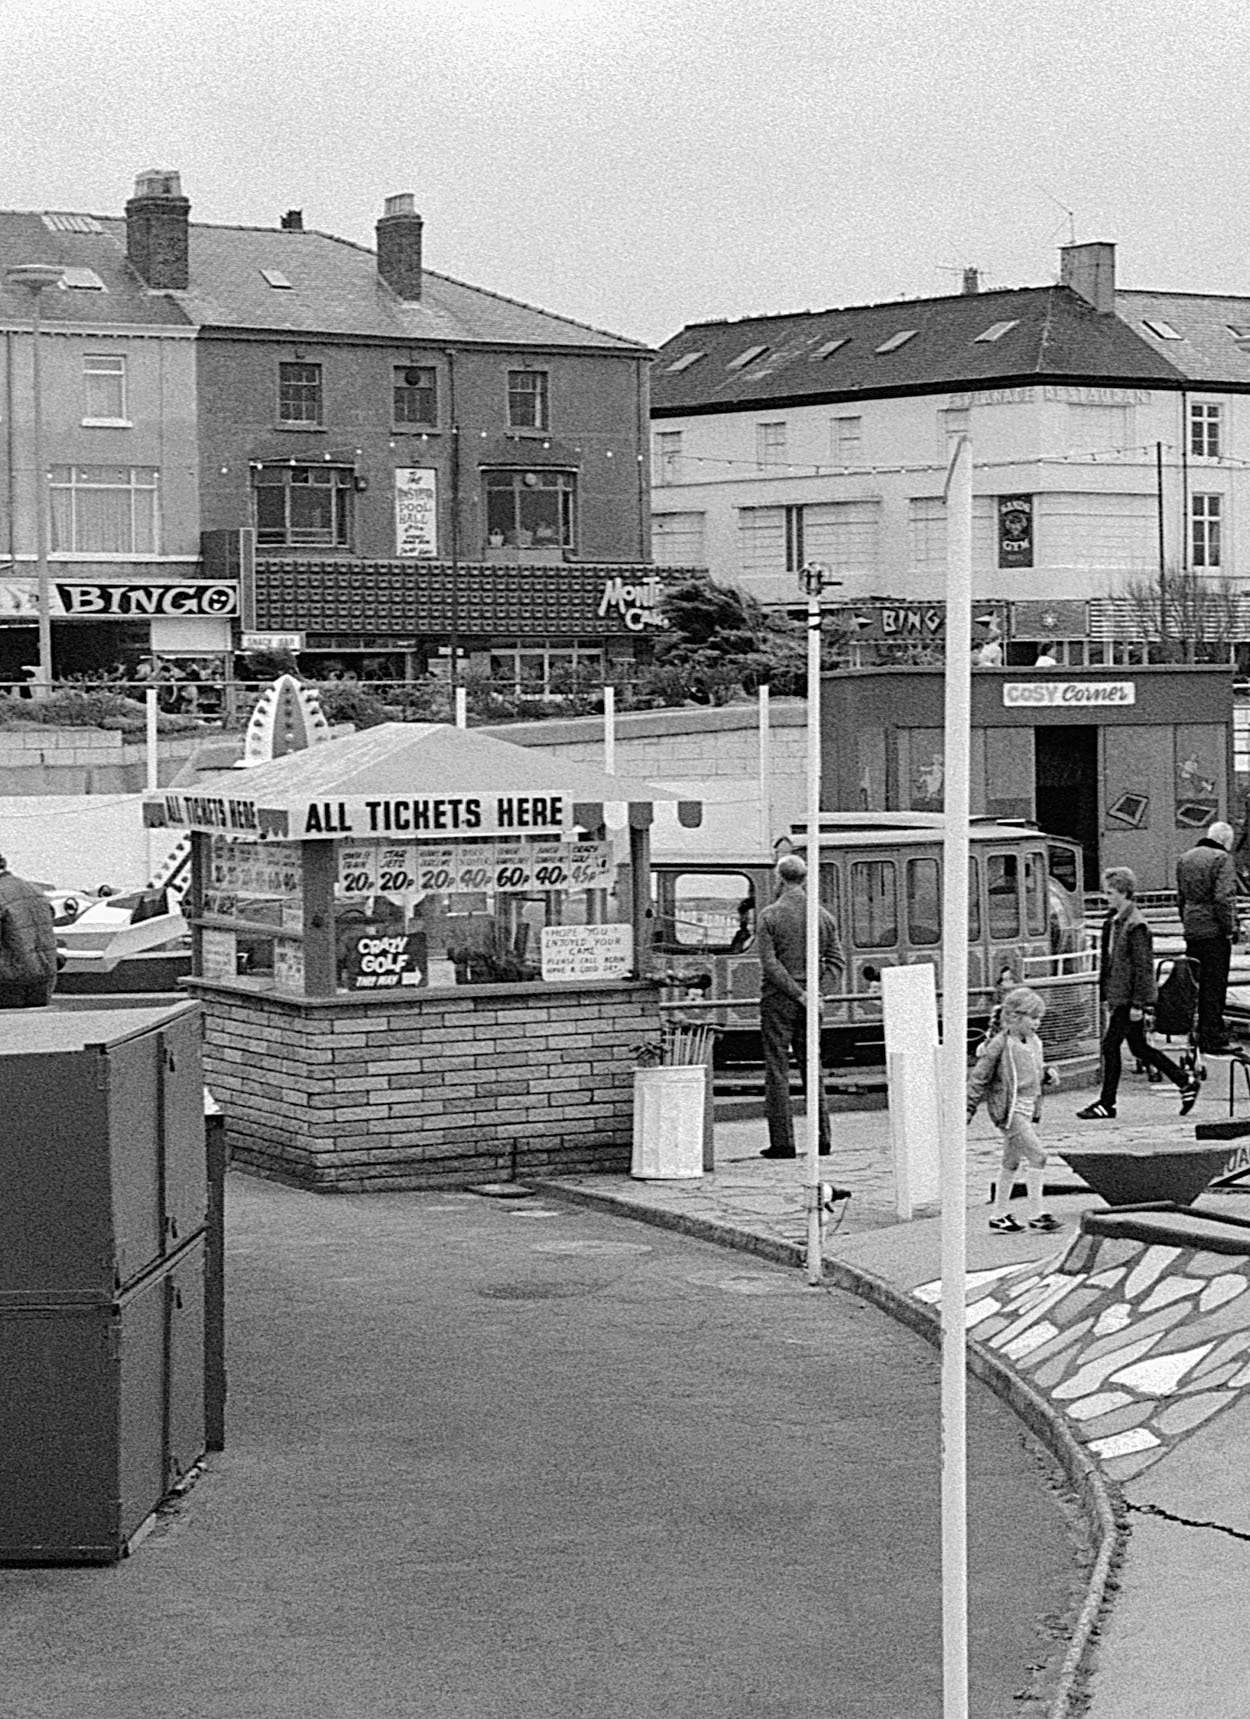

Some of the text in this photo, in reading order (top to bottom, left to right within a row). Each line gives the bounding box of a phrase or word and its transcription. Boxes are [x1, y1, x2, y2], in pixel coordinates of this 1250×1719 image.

[399, 502, 432, 513] POOL
[63, 585, 236, 614] BINGO
[1062, 684, 1128, 702] Corner
[165, 796, 257, 829] ALL TICKETS HERE
[305, 797, 563, 833] ALL TICKETS HERE
[344, 871, 375, 893] 20p
[380, 870, 415, 892] 20p
[421, 868, 456, 890] 20p
[460, 867, 492, 888] 40p
[496, 866, 530, 888] 60p
[535, 865, 568, 886] 40p
[357, 936, 409, 955] CRAZY
[361, 953, 409, 974] GOLF
